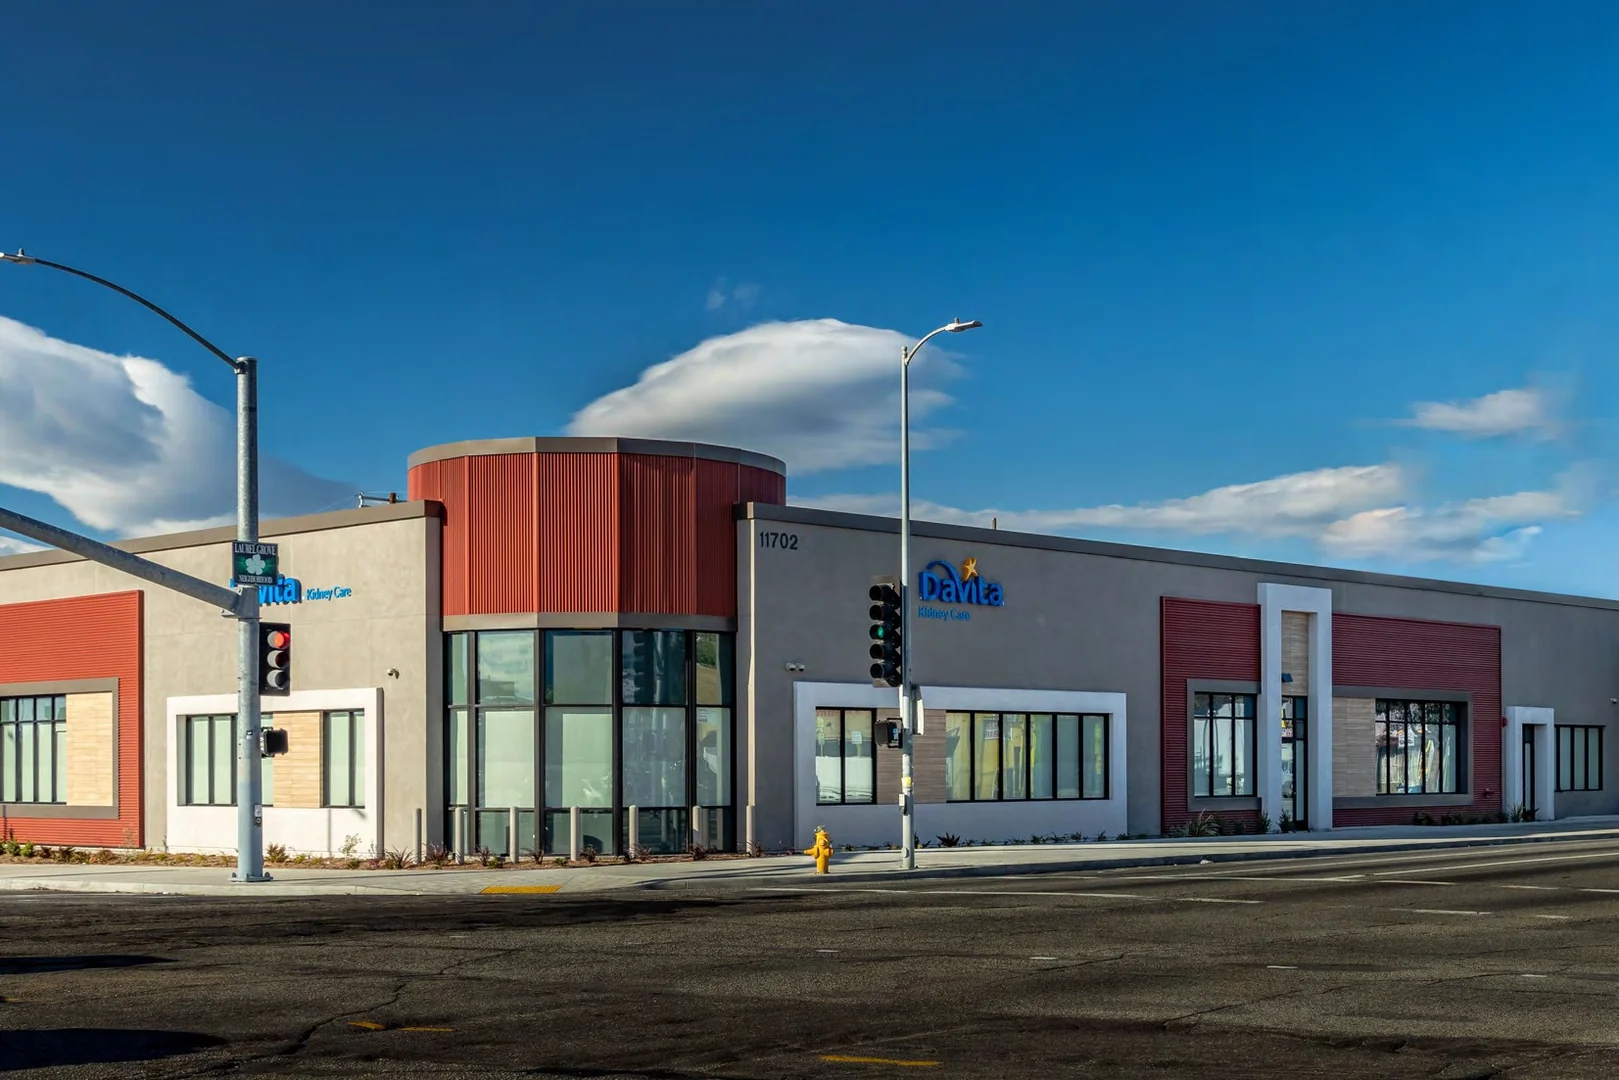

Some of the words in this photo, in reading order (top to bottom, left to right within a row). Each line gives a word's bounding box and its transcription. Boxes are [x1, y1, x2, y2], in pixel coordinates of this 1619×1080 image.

[760, 532, 798, 550] 11702
[234, 543, 256, 554] LAUREL
[256, 544, 276, 555] GROVE
[918, 562, 1004, 606] DaVita
[306, 587, 333, 601] Kidney
[334, 586, 352, 599] Care
[918, 607, 949, 620] Kidney
[950, 608, 971, 621] Care
